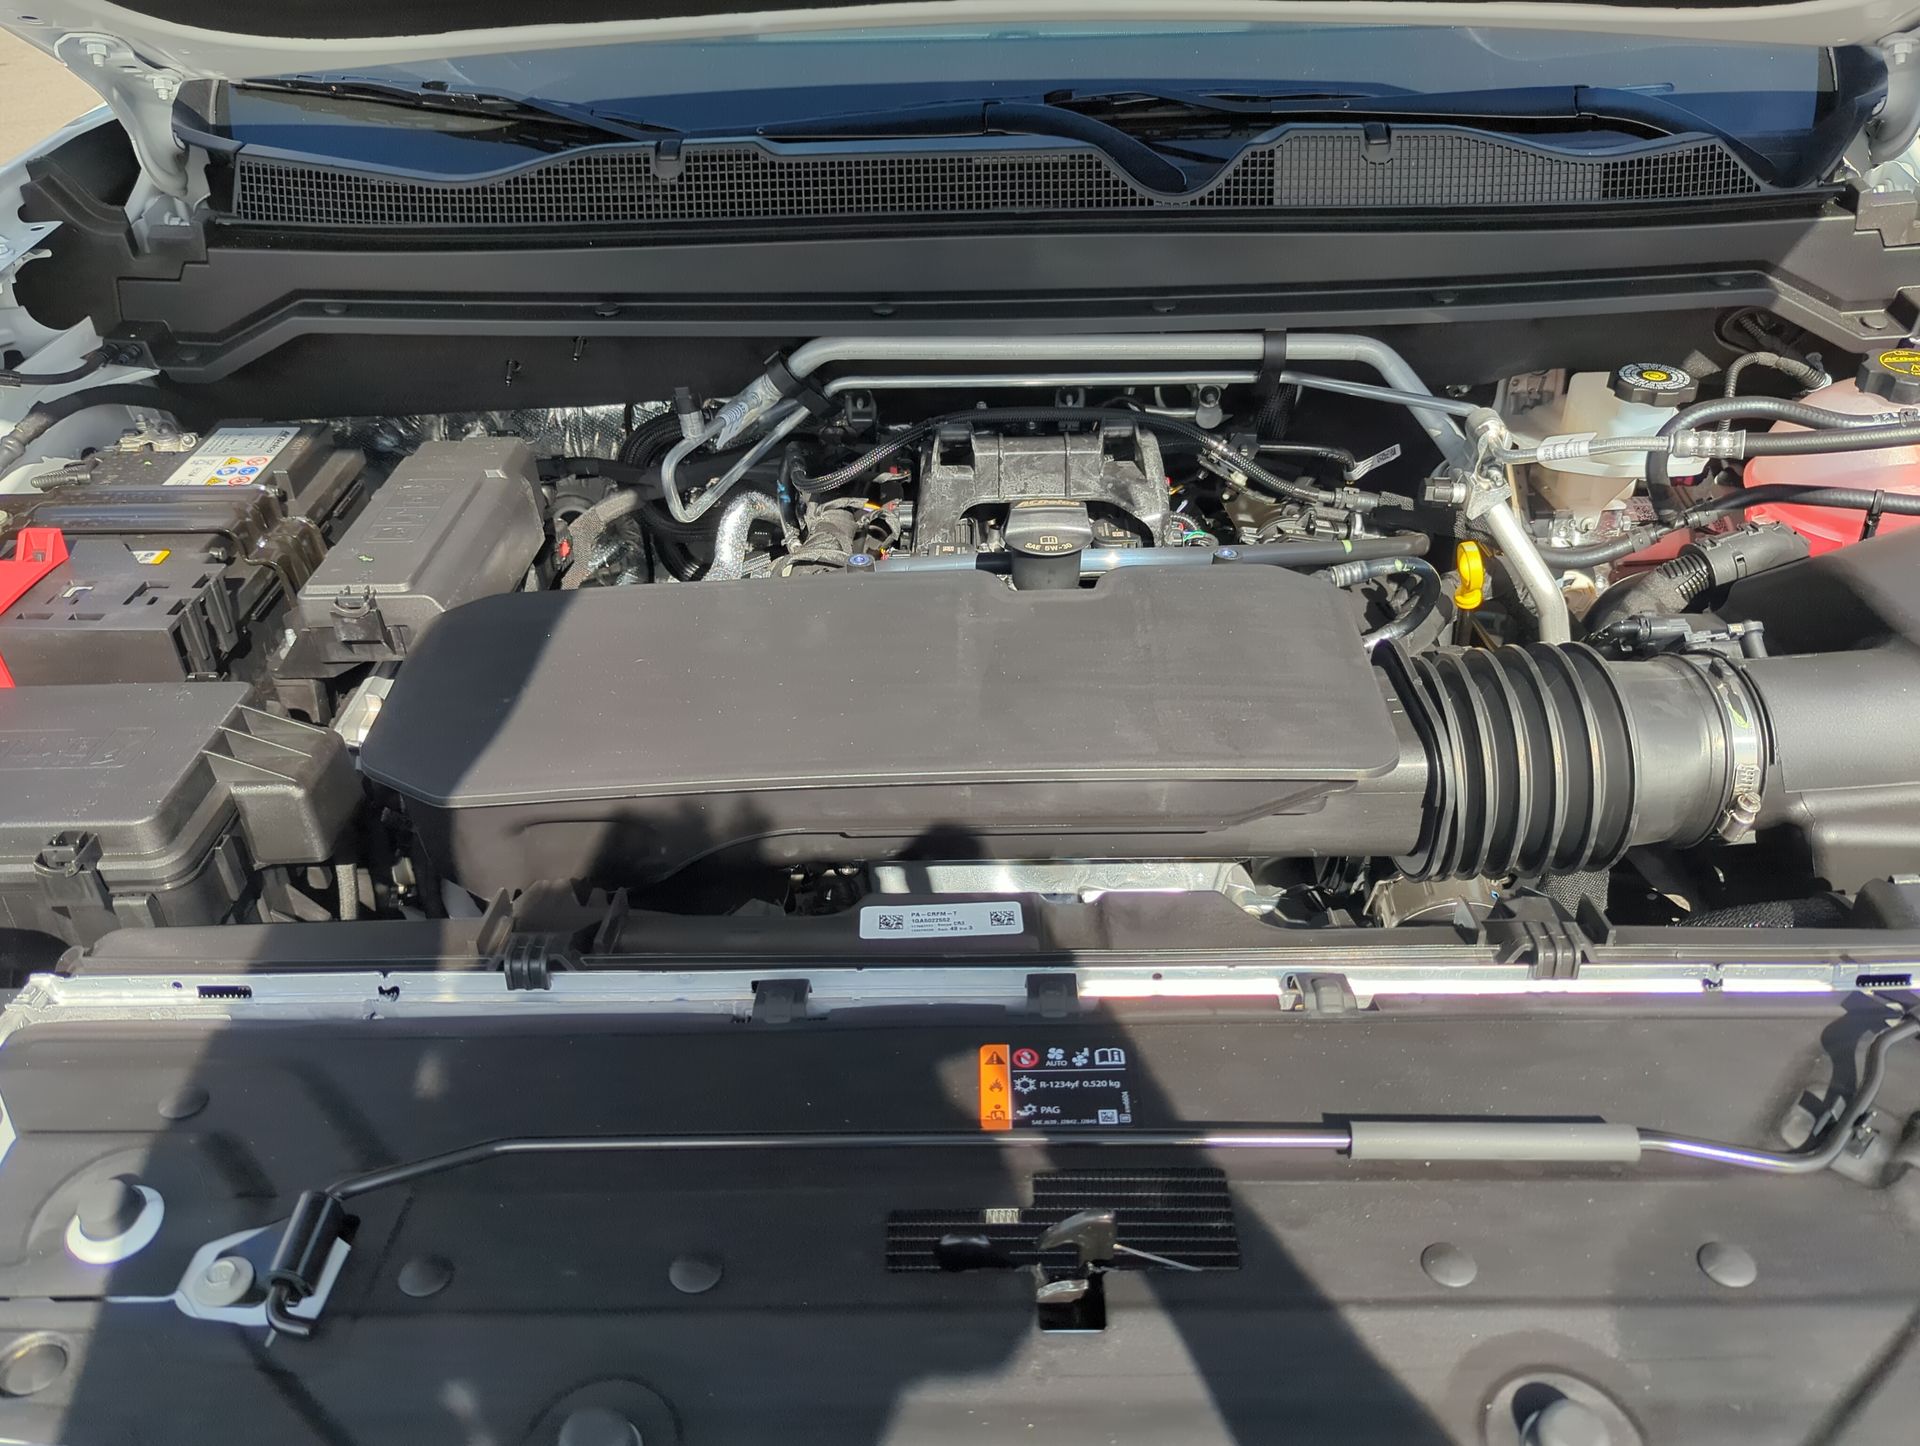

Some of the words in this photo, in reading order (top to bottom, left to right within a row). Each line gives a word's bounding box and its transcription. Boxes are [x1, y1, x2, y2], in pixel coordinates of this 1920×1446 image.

[1025, 543, 1042, 551] SAE
[1045, 542, 1073, 552] 5W-30
[1040, 1080, 1080, 1090] R-1234yf
[1082, 1080, 1107, 1088] 0.520
[1108, 1080, 1121, 1088] kg
[1040, 1106, 1061, 1114] PAG
